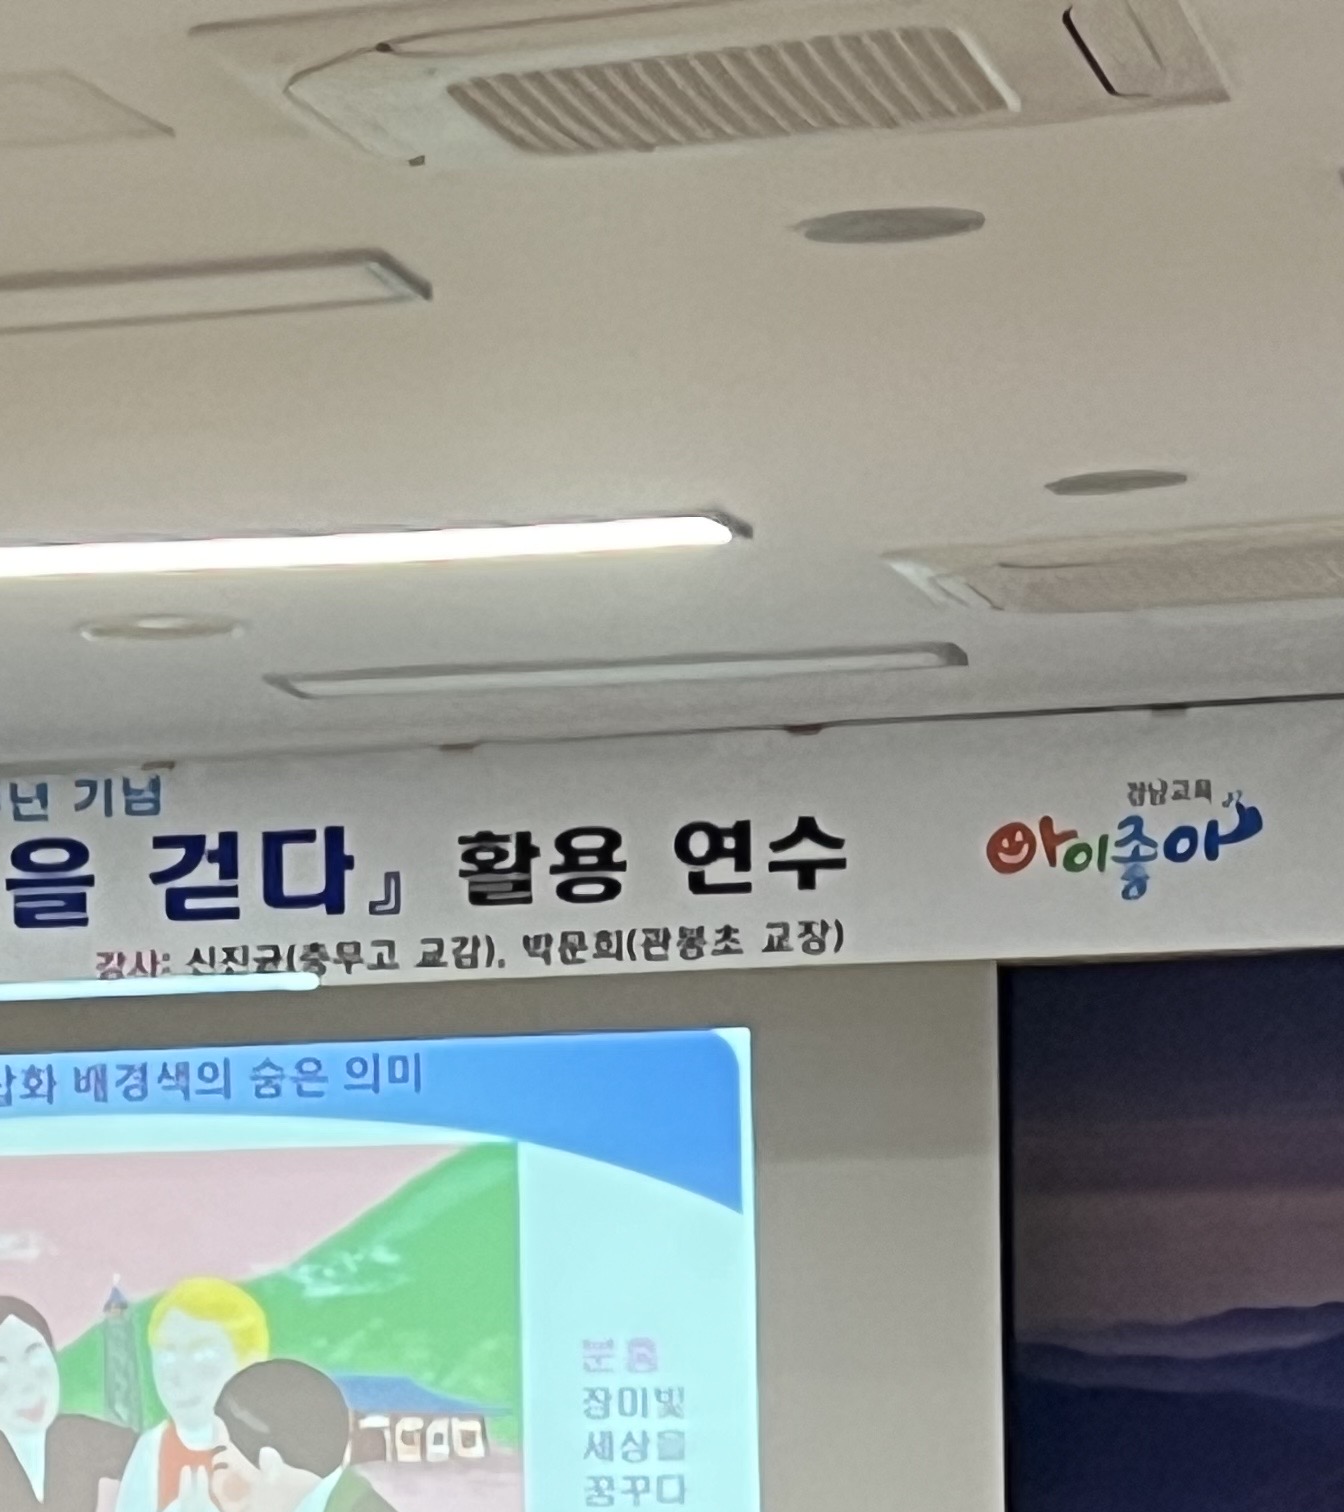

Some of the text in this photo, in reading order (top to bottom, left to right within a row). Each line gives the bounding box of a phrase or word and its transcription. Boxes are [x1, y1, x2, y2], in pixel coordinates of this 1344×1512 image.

[74, 775, 162, 818] 기념
[458, 826, 629, 907] 활용
[673, 815, 849, 896] 연수
[761, 918, 845, 956] 교장)
[73, 1057, 232, 1103] 배경색의
[250, 1056, 329, 1099] 숨은
[344, 1052, 421, 1094] 의미
